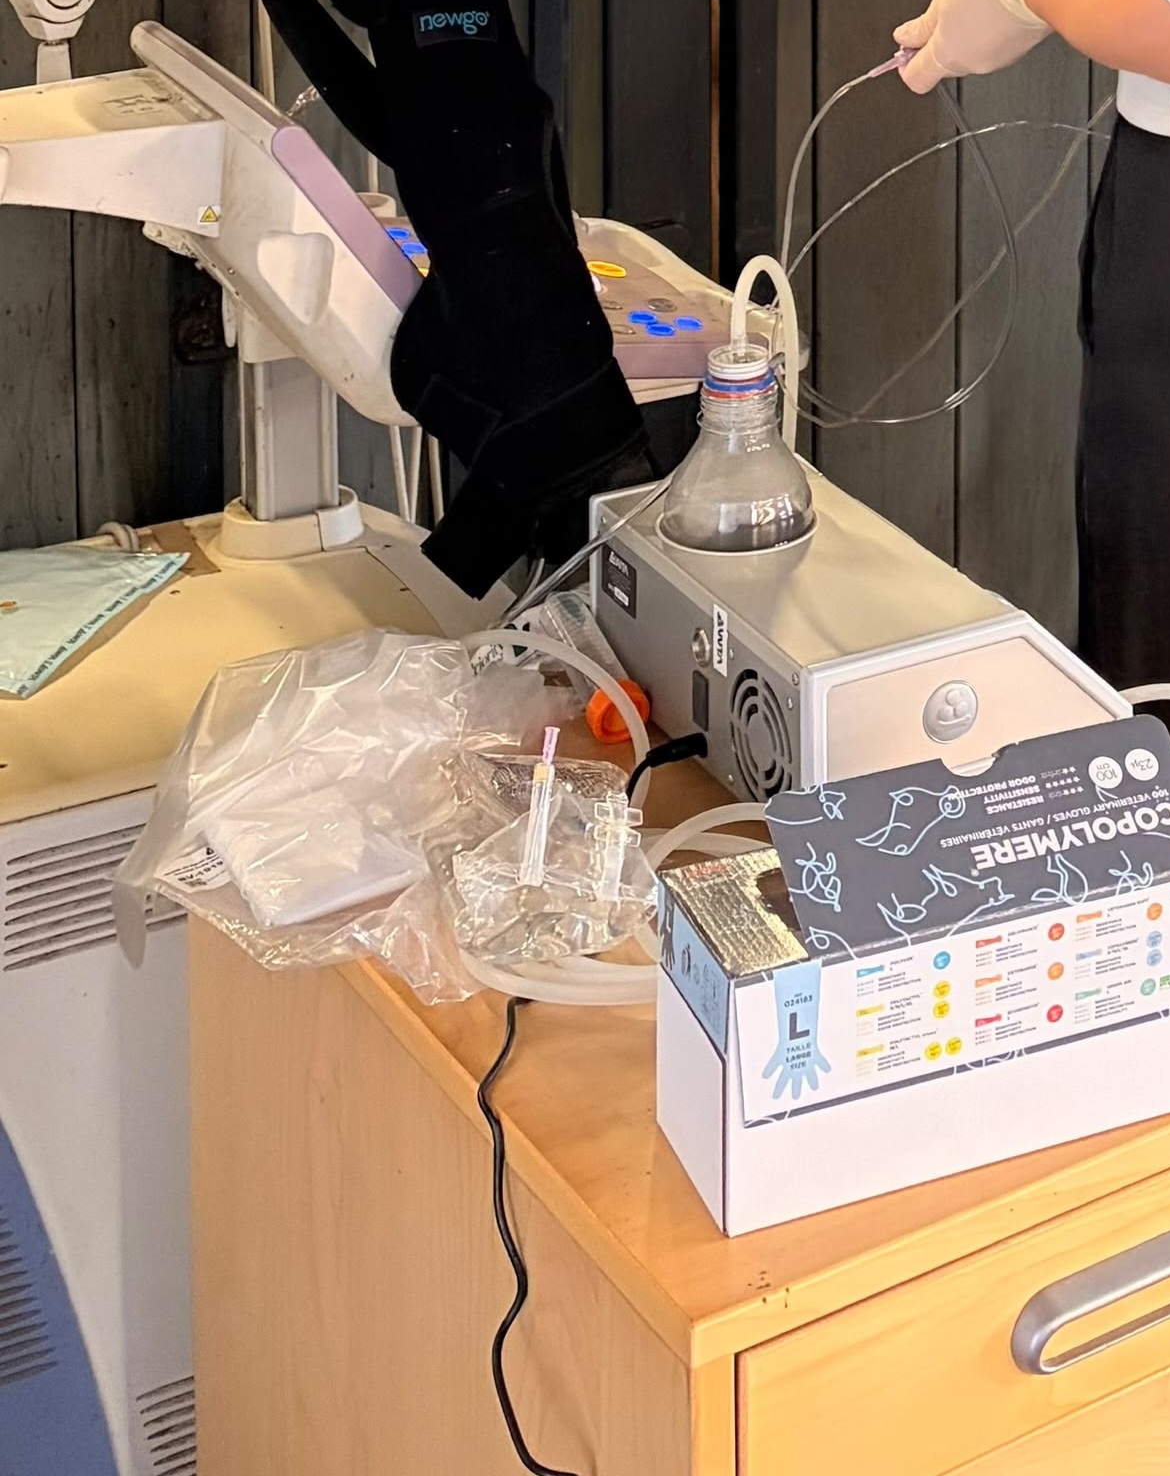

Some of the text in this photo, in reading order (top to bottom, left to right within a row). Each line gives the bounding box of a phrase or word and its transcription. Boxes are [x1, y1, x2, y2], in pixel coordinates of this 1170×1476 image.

[419, 11, 489, 35] newgo
[1009, 775, 1036, 788] ODOR
[1096, 769, 1118, 782] 100
[983, 784, 1040, 804] SENSITIVITY
[985, 795, 1044, 815] RESISTANCE
[1093, 792, 1152, 814] VETERINARY
[1046, 814, 1052, 825] /
[1052, 806, 1091, 823] GLOVES
[1011, 817, 1045, 833] GANTS
[789, 1012, 810, 1041] L
[786, 1042, 812, 1055] TAILLE
[786, 1051, 812, 1064] LARGE
[789, 1061, 807, 1071] SIZE
